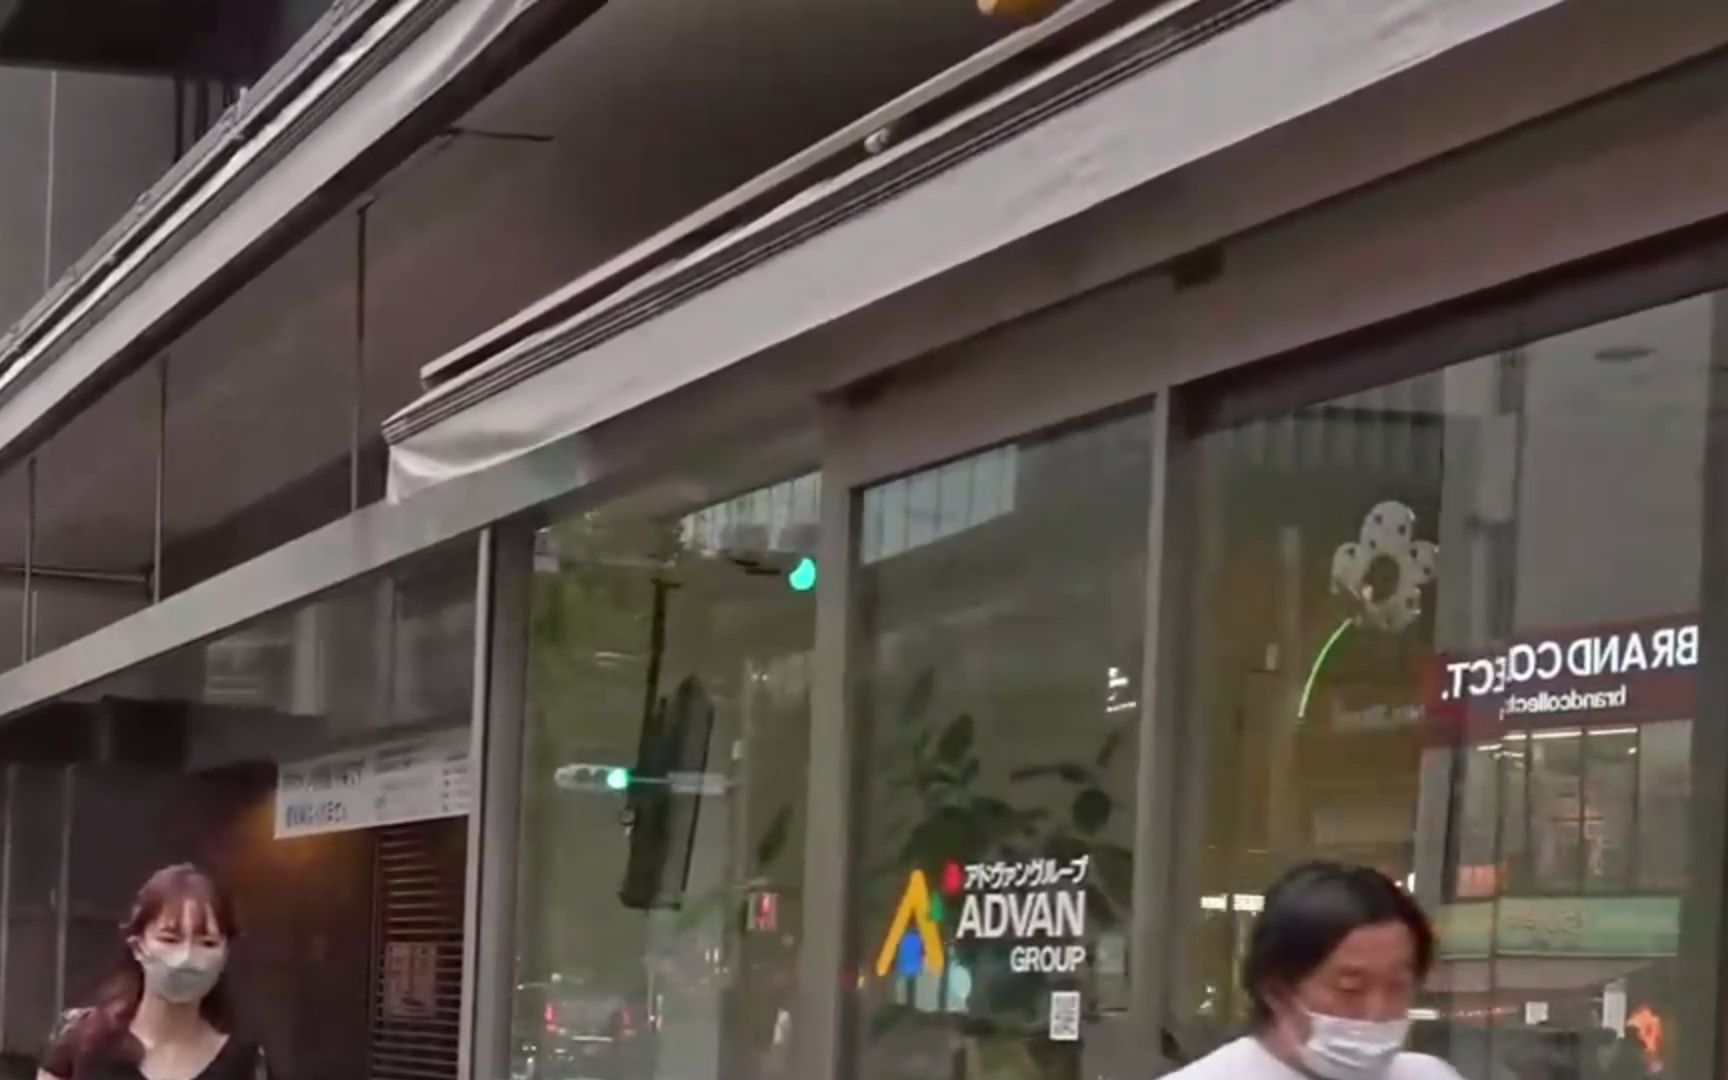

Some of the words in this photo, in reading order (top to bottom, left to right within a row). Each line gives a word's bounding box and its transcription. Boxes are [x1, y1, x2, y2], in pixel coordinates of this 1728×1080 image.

[964, 854, 1089, 889] アドヴァングループ
[955, 890, 1086, 938] ADVAN
[1010, 946, 1086, 972] GROUP
